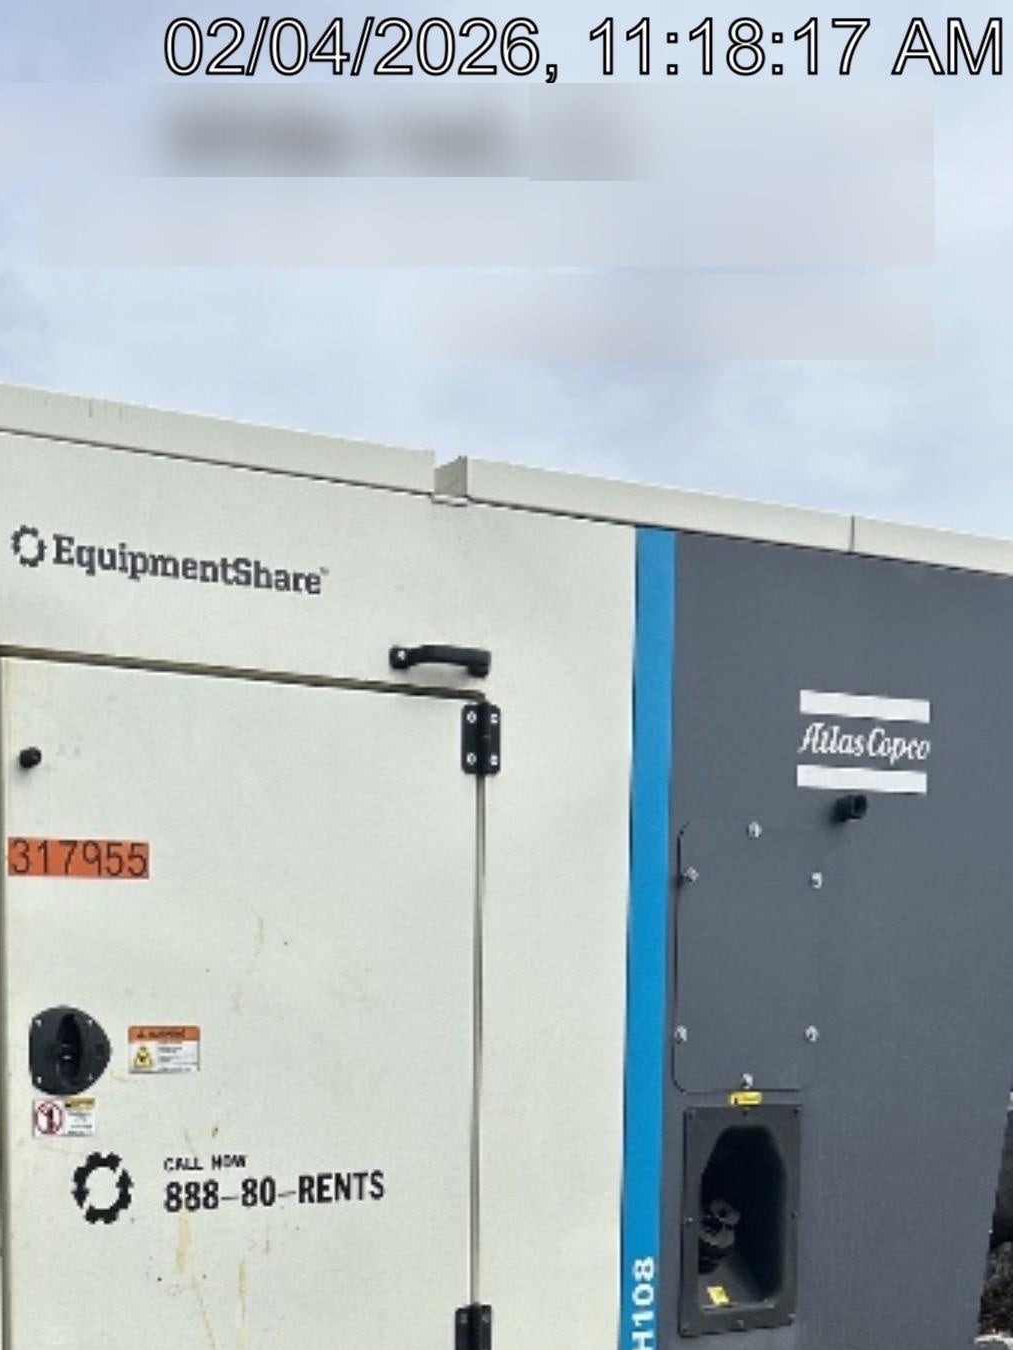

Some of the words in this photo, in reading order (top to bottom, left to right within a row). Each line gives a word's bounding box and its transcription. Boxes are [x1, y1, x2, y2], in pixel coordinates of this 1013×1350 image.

[52, 533, 322, 595] EquipmentShare
[12, 839, 148, 877] 317955
[164, 1157, 204, 1172] CALL
[211, 1154, 247, 1170] NOW
[163, 1169, 385, 1213] 888-80-RENTS
